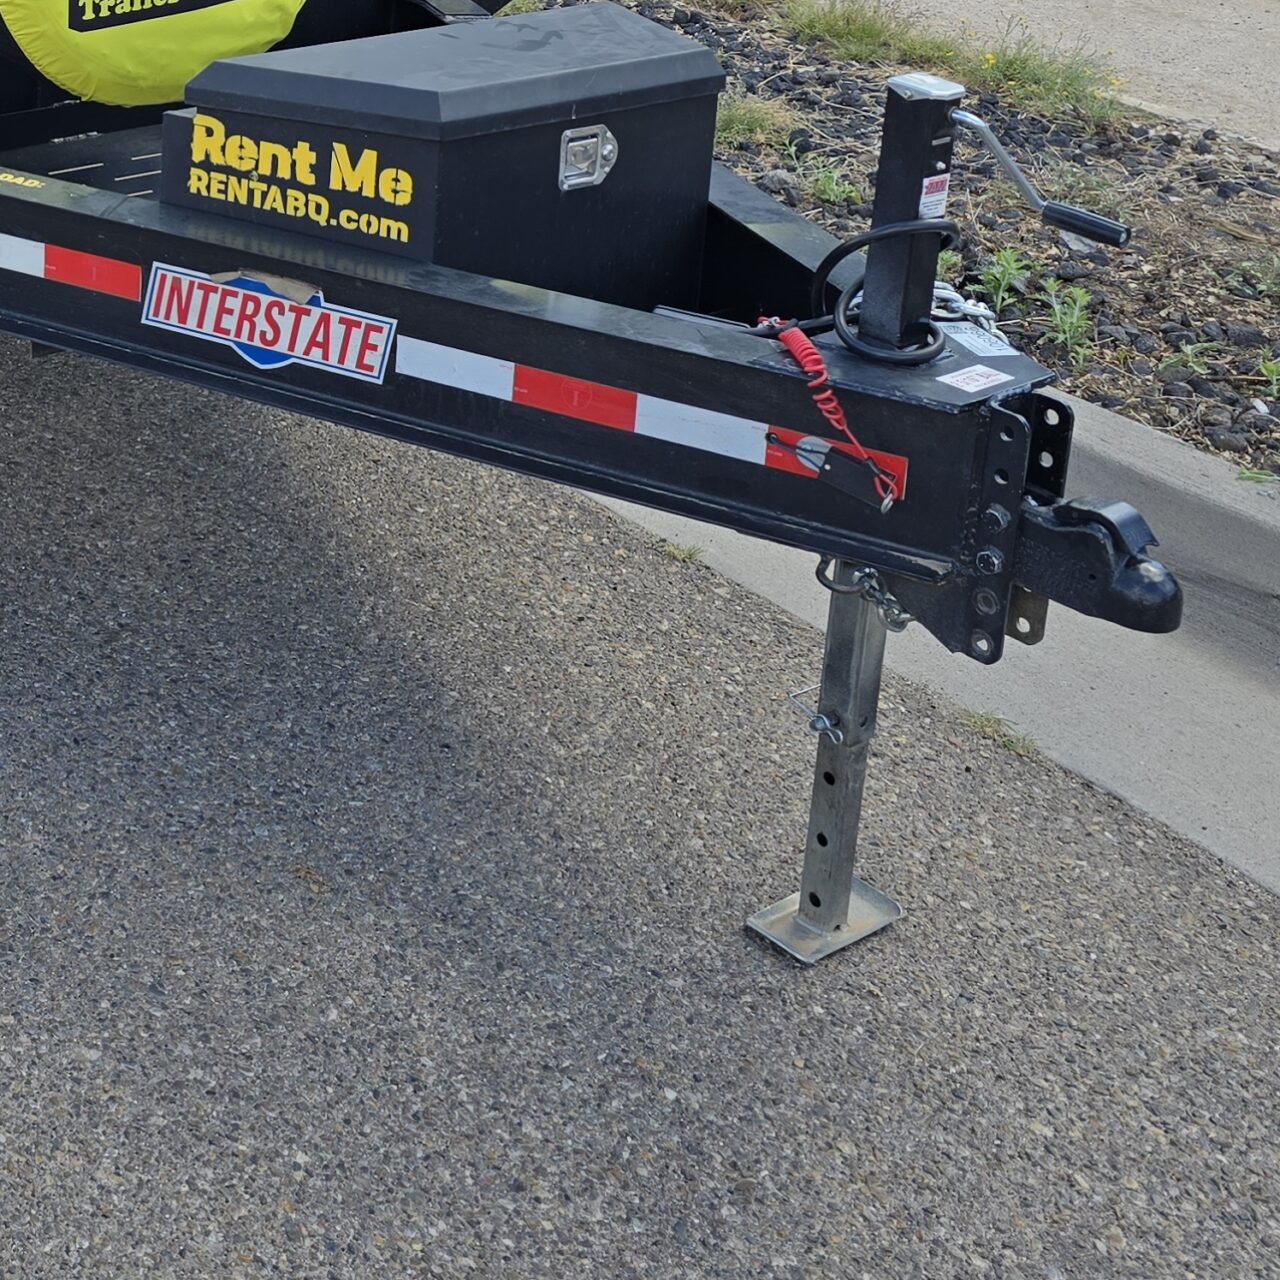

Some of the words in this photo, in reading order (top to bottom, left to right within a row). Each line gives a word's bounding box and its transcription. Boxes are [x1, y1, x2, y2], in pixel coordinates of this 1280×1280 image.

[187, 167, 410, 243] RENTABQ.com
[191, 113, 316, 186] Rent
[329, 141, 414, 207] Me
[151, 273, 385, 374] INTERSTATE
